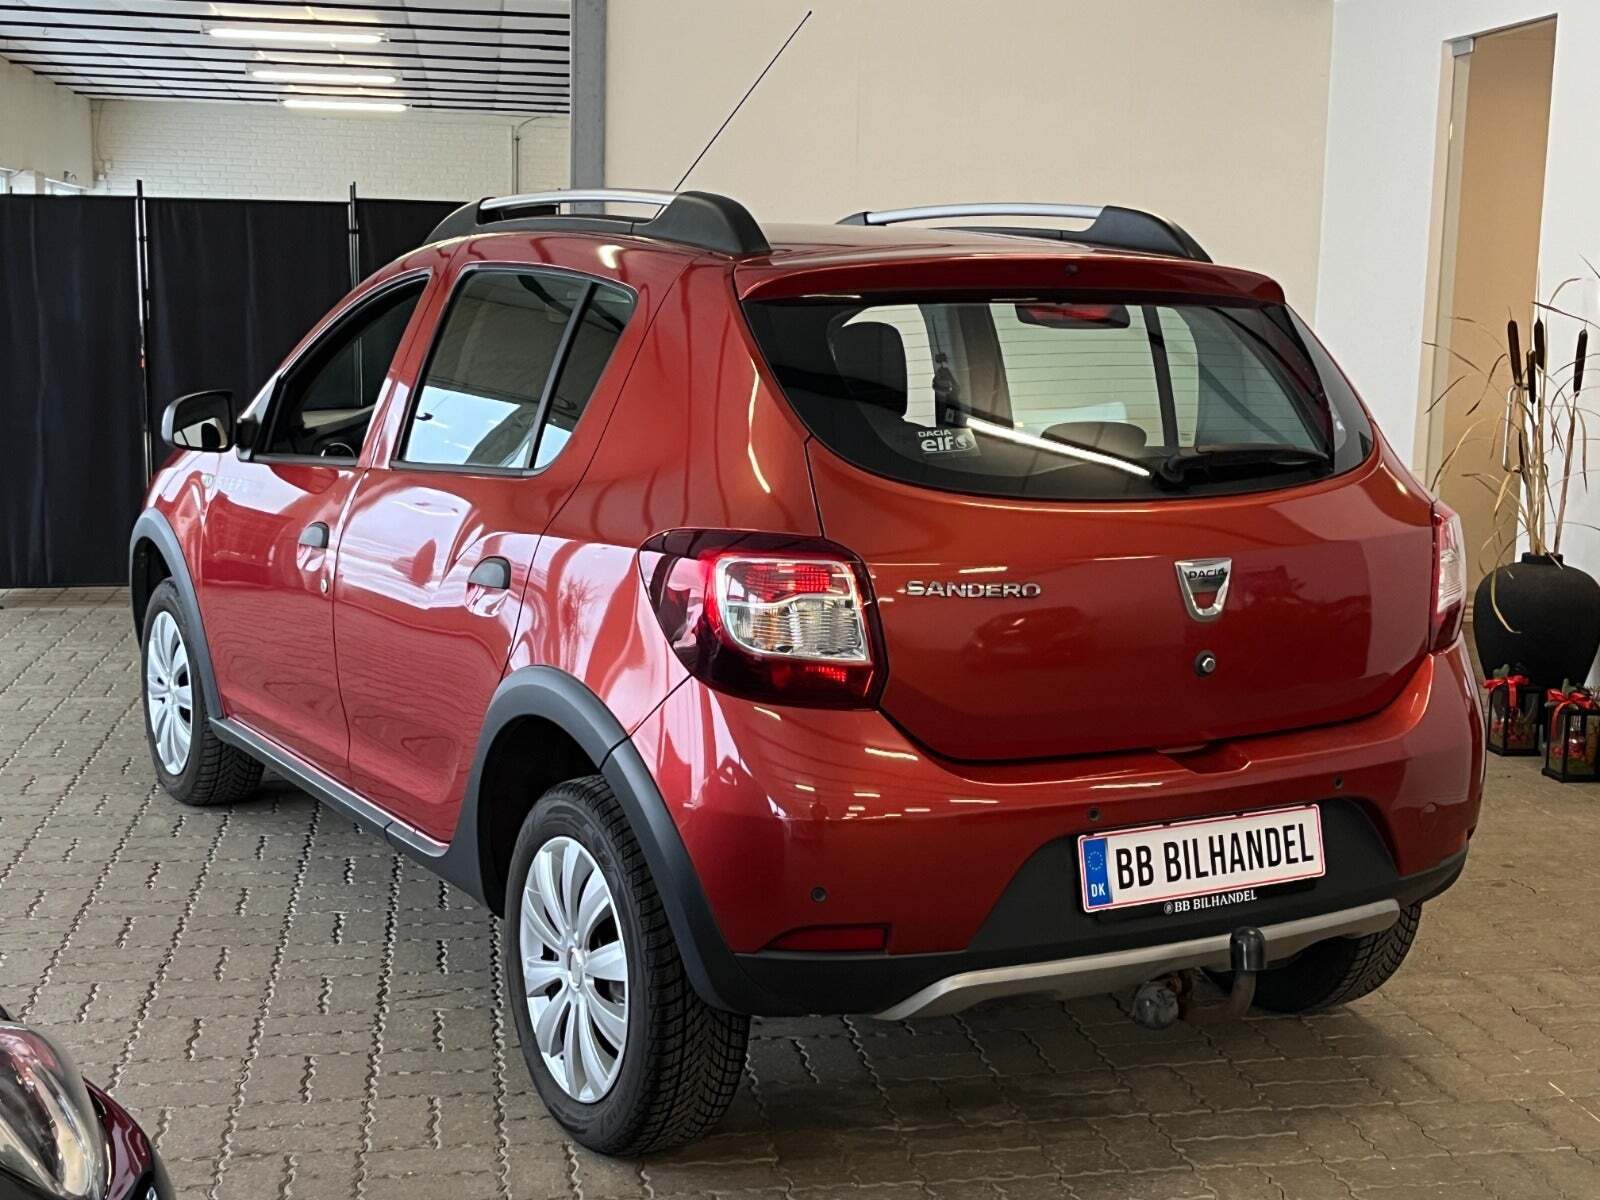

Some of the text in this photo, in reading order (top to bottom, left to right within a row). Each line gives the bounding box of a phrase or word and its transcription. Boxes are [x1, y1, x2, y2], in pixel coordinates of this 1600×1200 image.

[918, 429, 952, 438] DACIA
[921, 436, 954, 452] elf
[1189, 567, 1225, 579] DACIA
[906, 580, 1041, 598] SANDERO
[1116, 823, 1314, 890] BB BILHANDEL
[1091, 882, 1105, 898] DK
[1174, 889, 1257, 913] BB BILHANDEL
